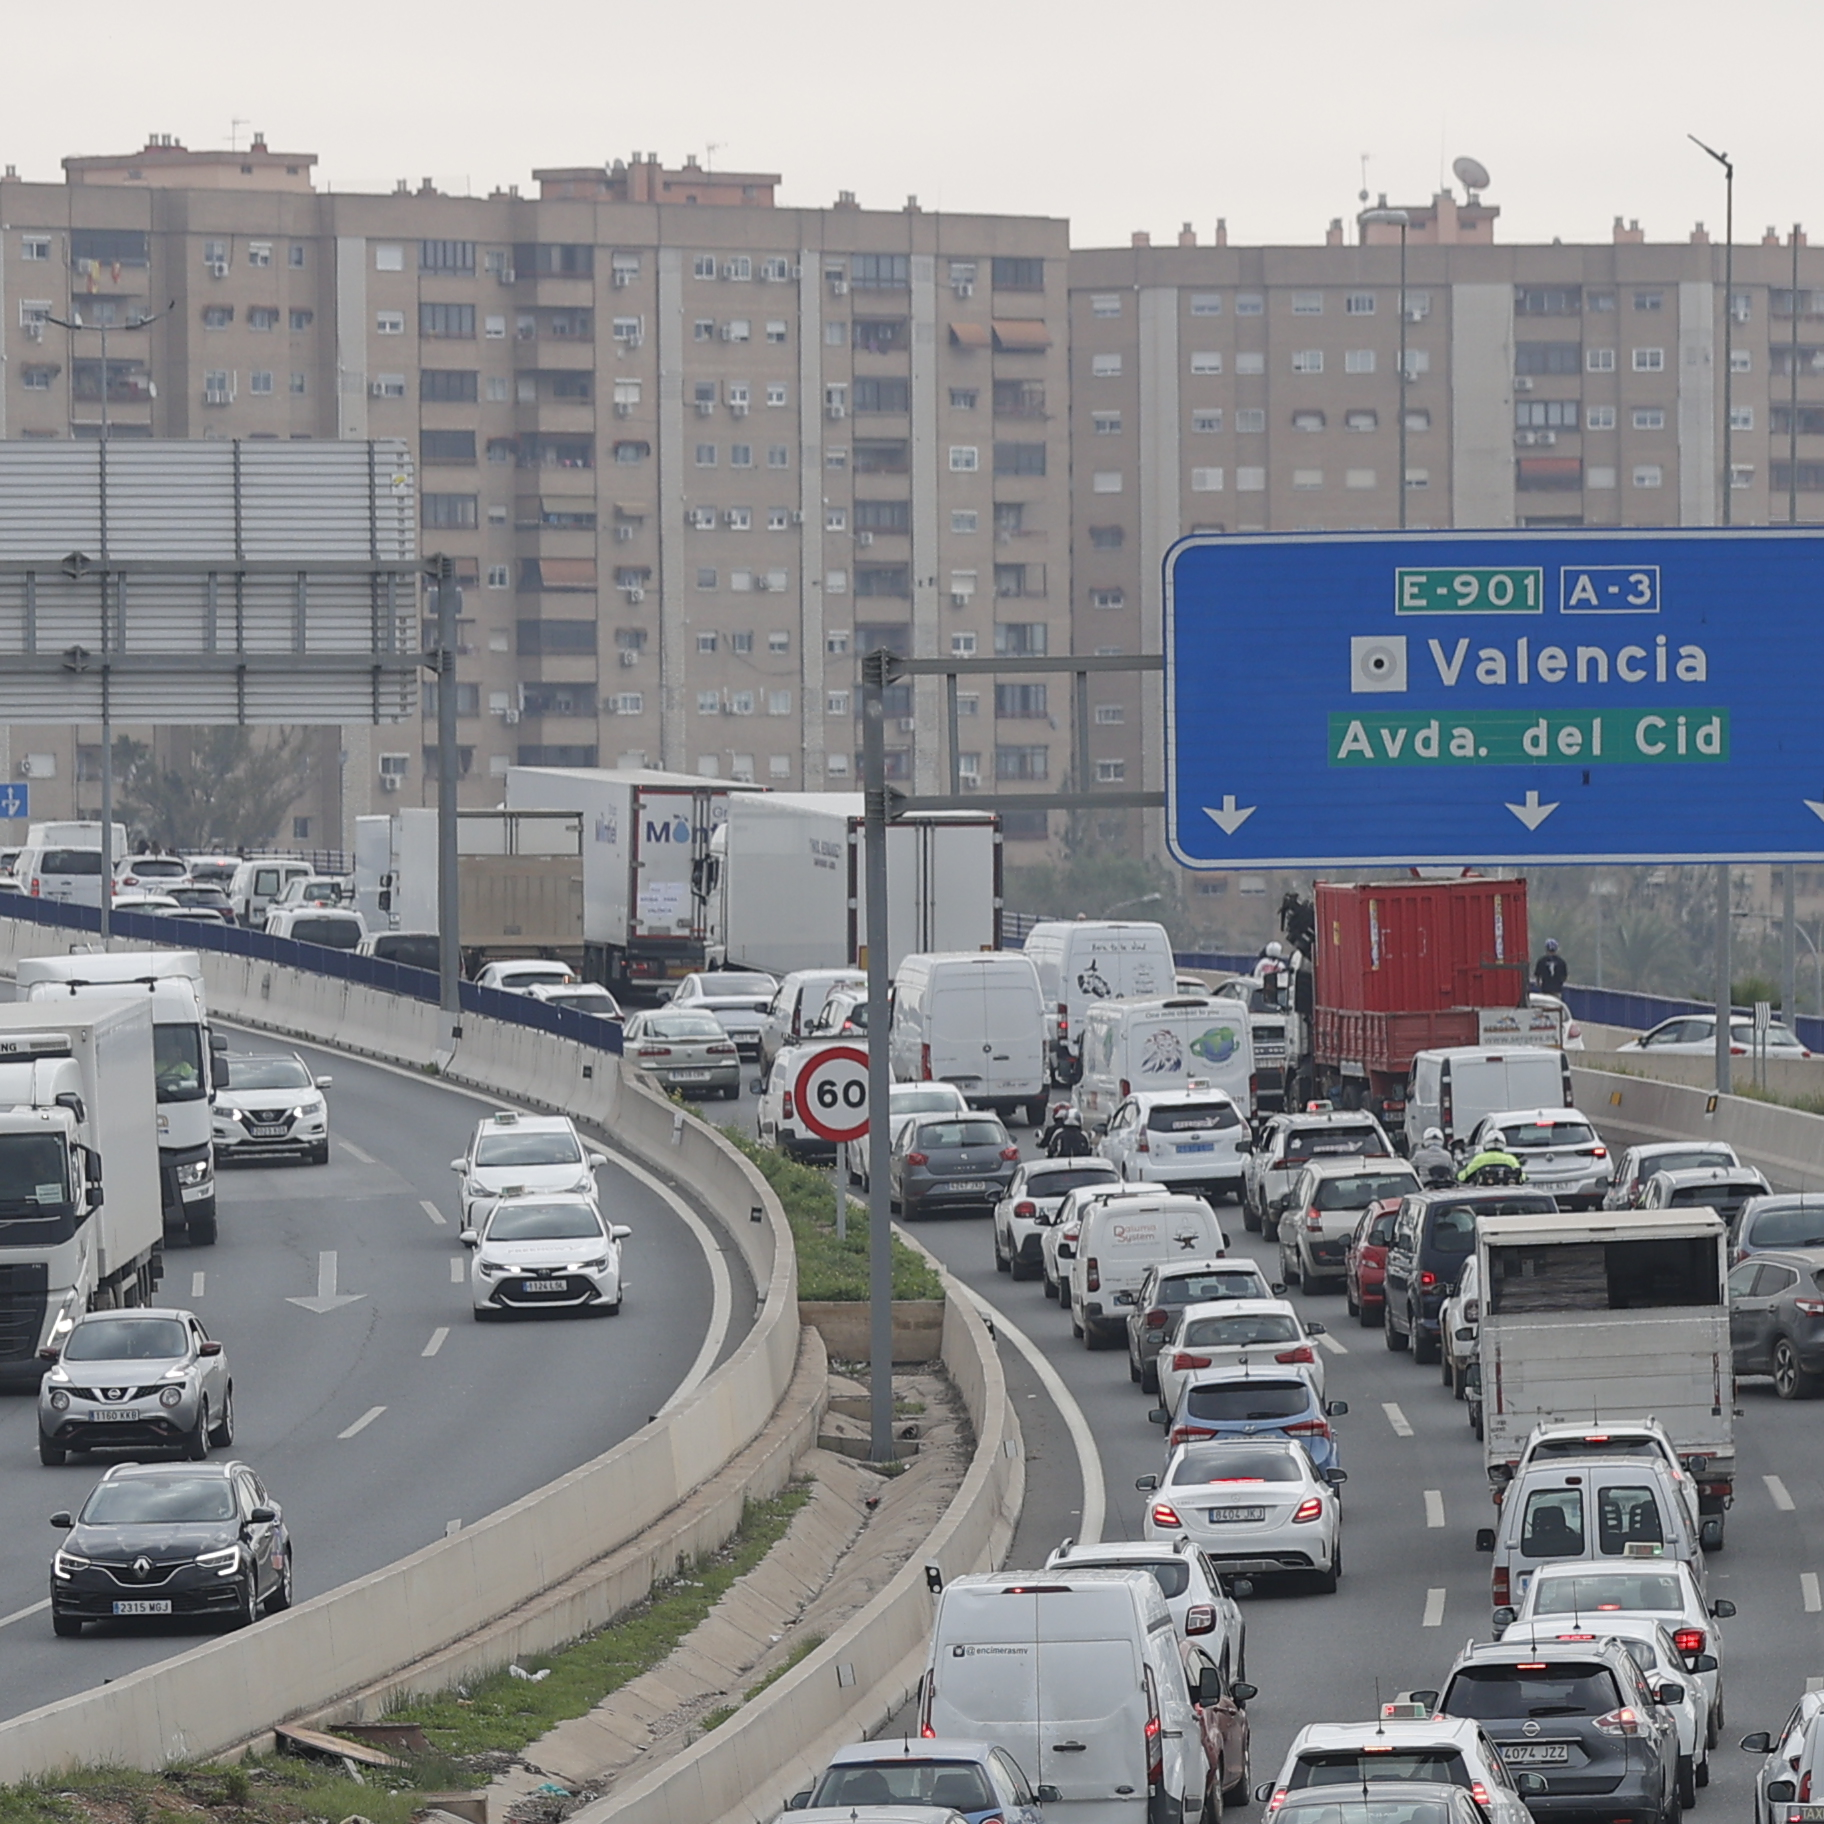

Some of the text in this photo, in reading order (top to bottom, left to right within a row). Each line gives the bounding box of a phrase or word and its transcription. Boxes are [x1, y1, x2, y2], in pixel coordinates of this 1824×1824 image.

[1403, 574, 1538, 608] E-901
[1569, 572, 1653, 606] A-3
[1427, 635, 1709, 686] Valencia
[1336, 714, 1723, 762] Avda. del Cid
[817, 1079, 866, 1108] 60
[120, 1601, 169, 1613] 2315 MGJ
[1504, 1745, 1565, 1760] 4074 JZZ
